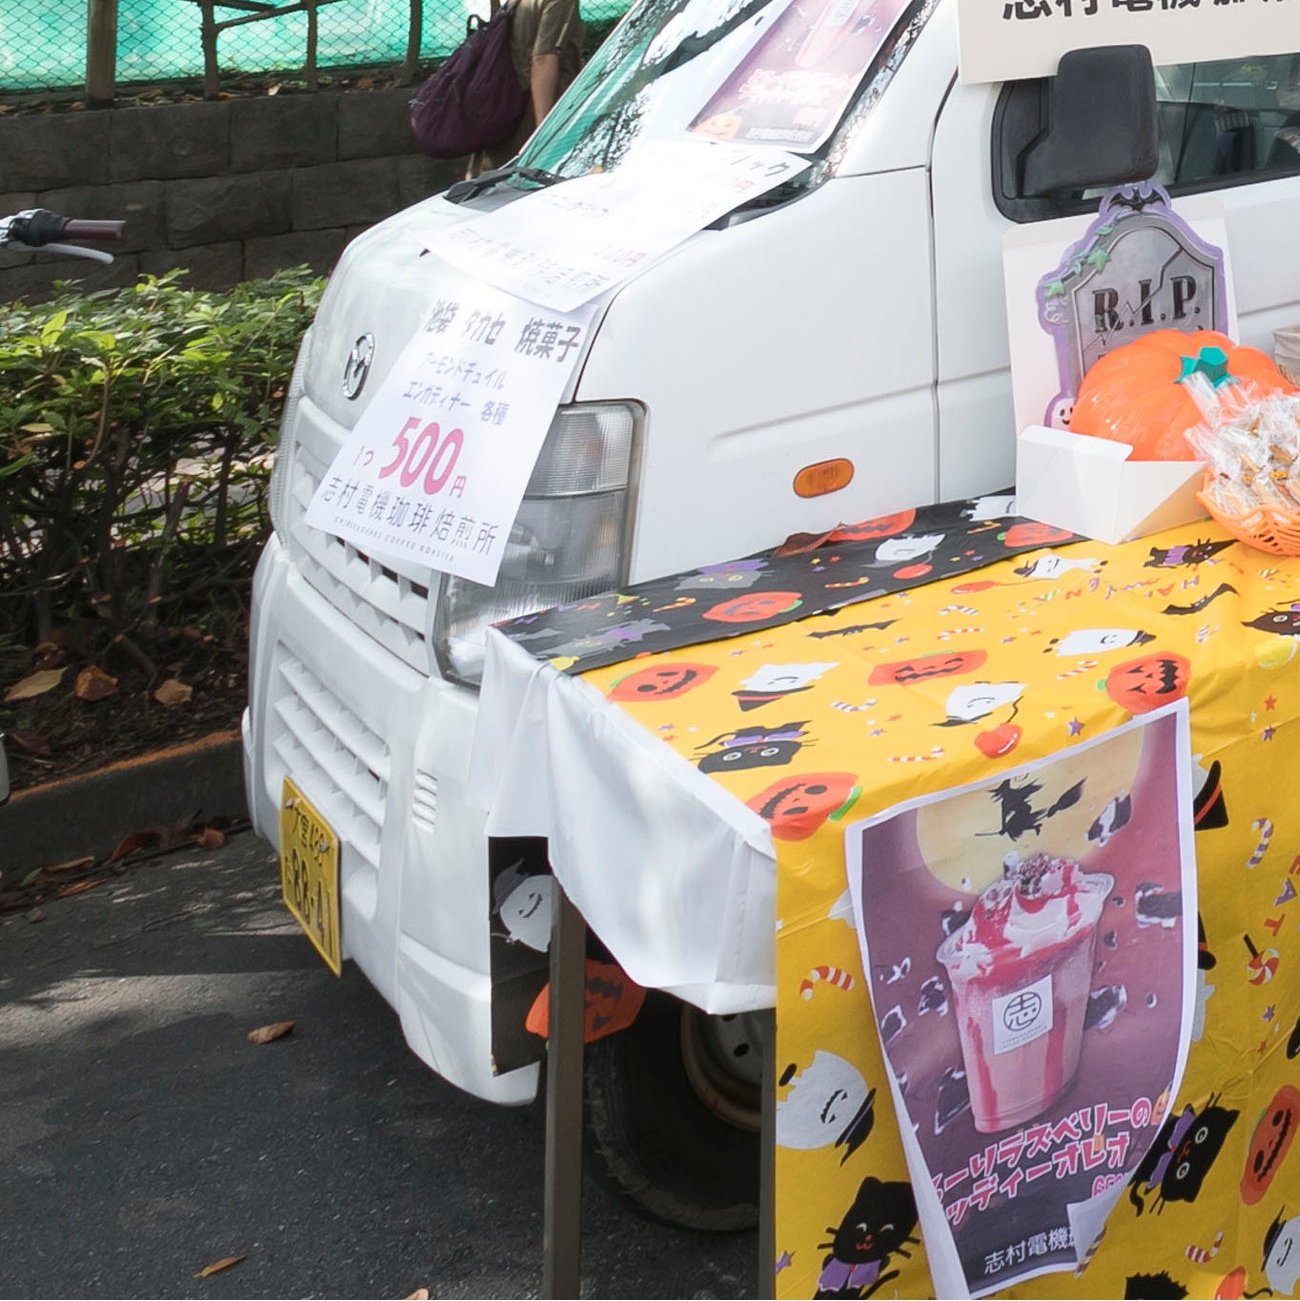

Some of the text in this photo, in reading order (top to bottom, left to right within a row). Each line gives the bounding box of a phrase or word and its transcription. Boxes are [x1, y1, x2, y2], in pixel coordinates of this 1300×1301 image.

[1092, 275, 1201, 334] R.I.P.
[460, 310, 507, 346] タカセ
[513, 317, 582, 364] 焼菓子
[479, 400, 510, 426] 各種
[321, 475, 500, 557] 志村電機珈琲焙煎所
